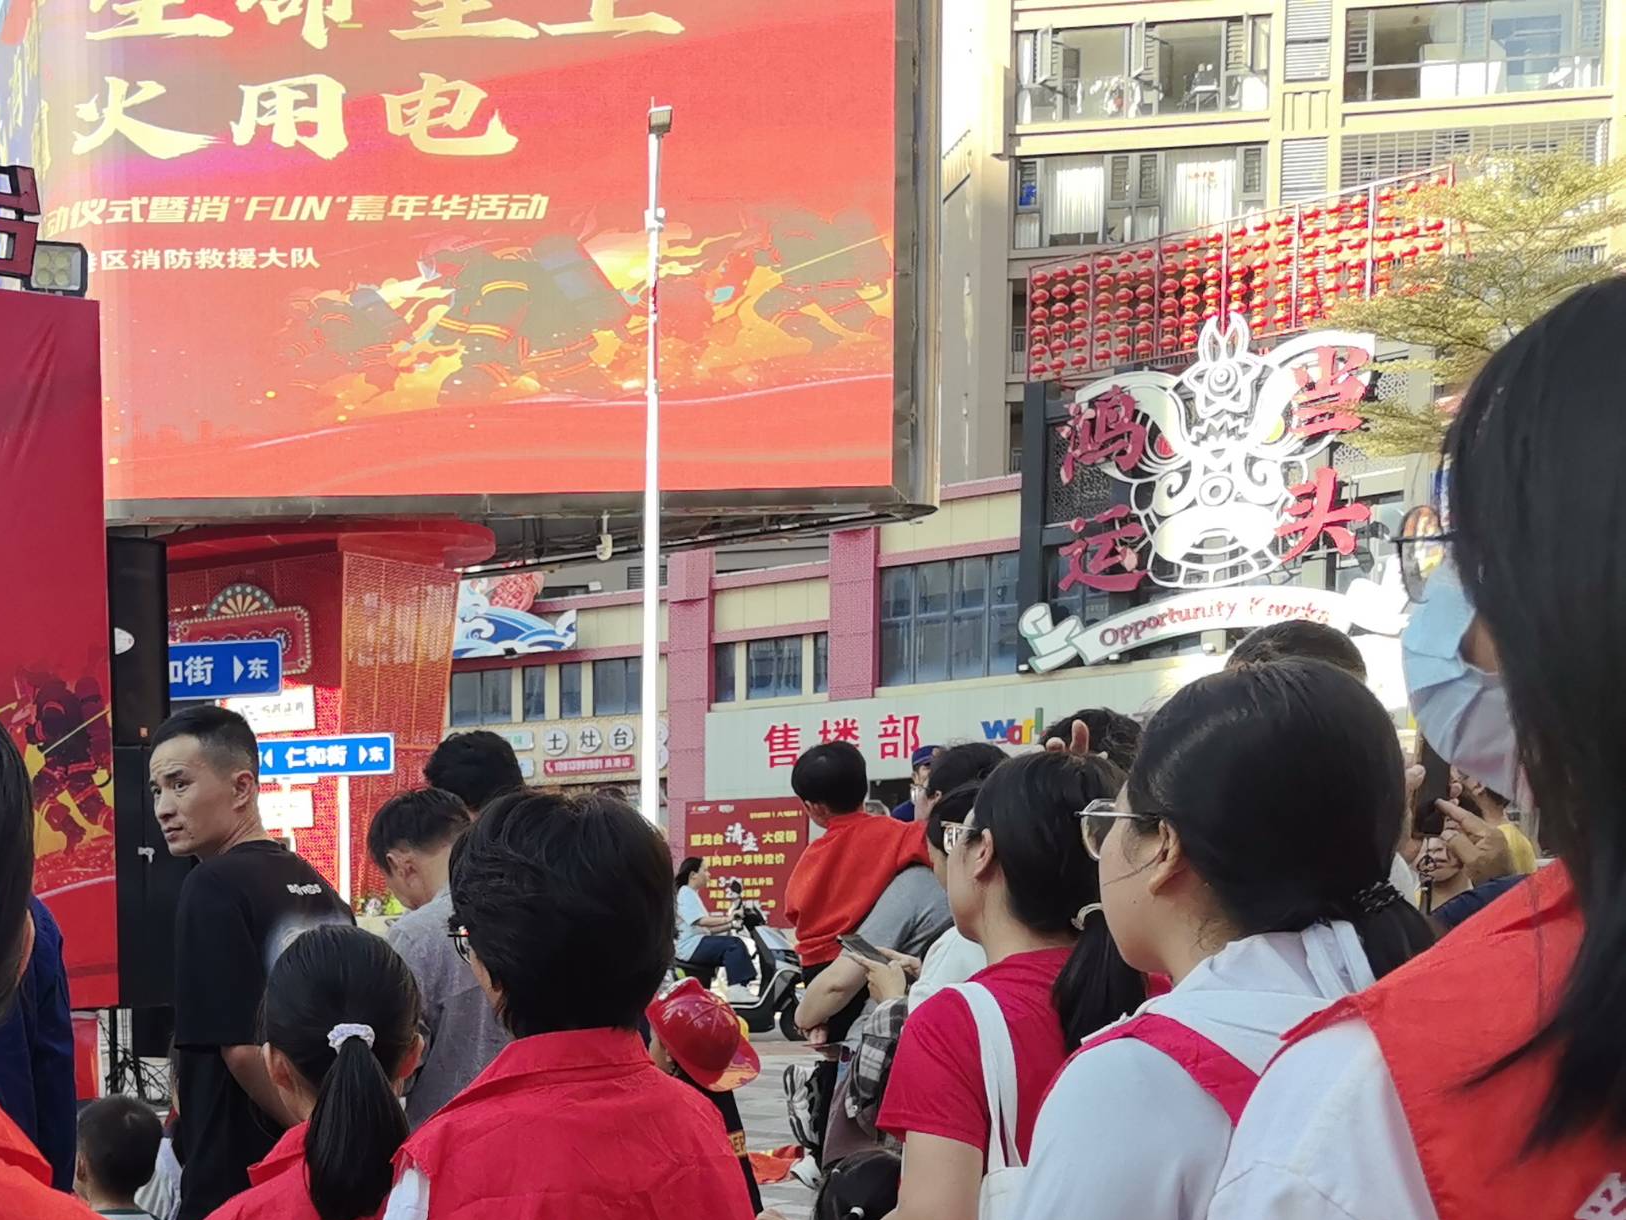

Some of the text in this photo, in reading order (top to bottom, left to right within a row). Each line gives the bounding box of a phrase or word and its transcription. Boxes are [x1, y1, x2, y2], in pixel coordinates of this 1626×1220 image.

[1099, 600, 1237, 647] Opportunity
[248, 657, 270, 680] 东
[547, 727, 628, 752] 土灶台
[764, 714, 922, 769] 售楼部
[284, 744, 385, 769] 仁和街 东
